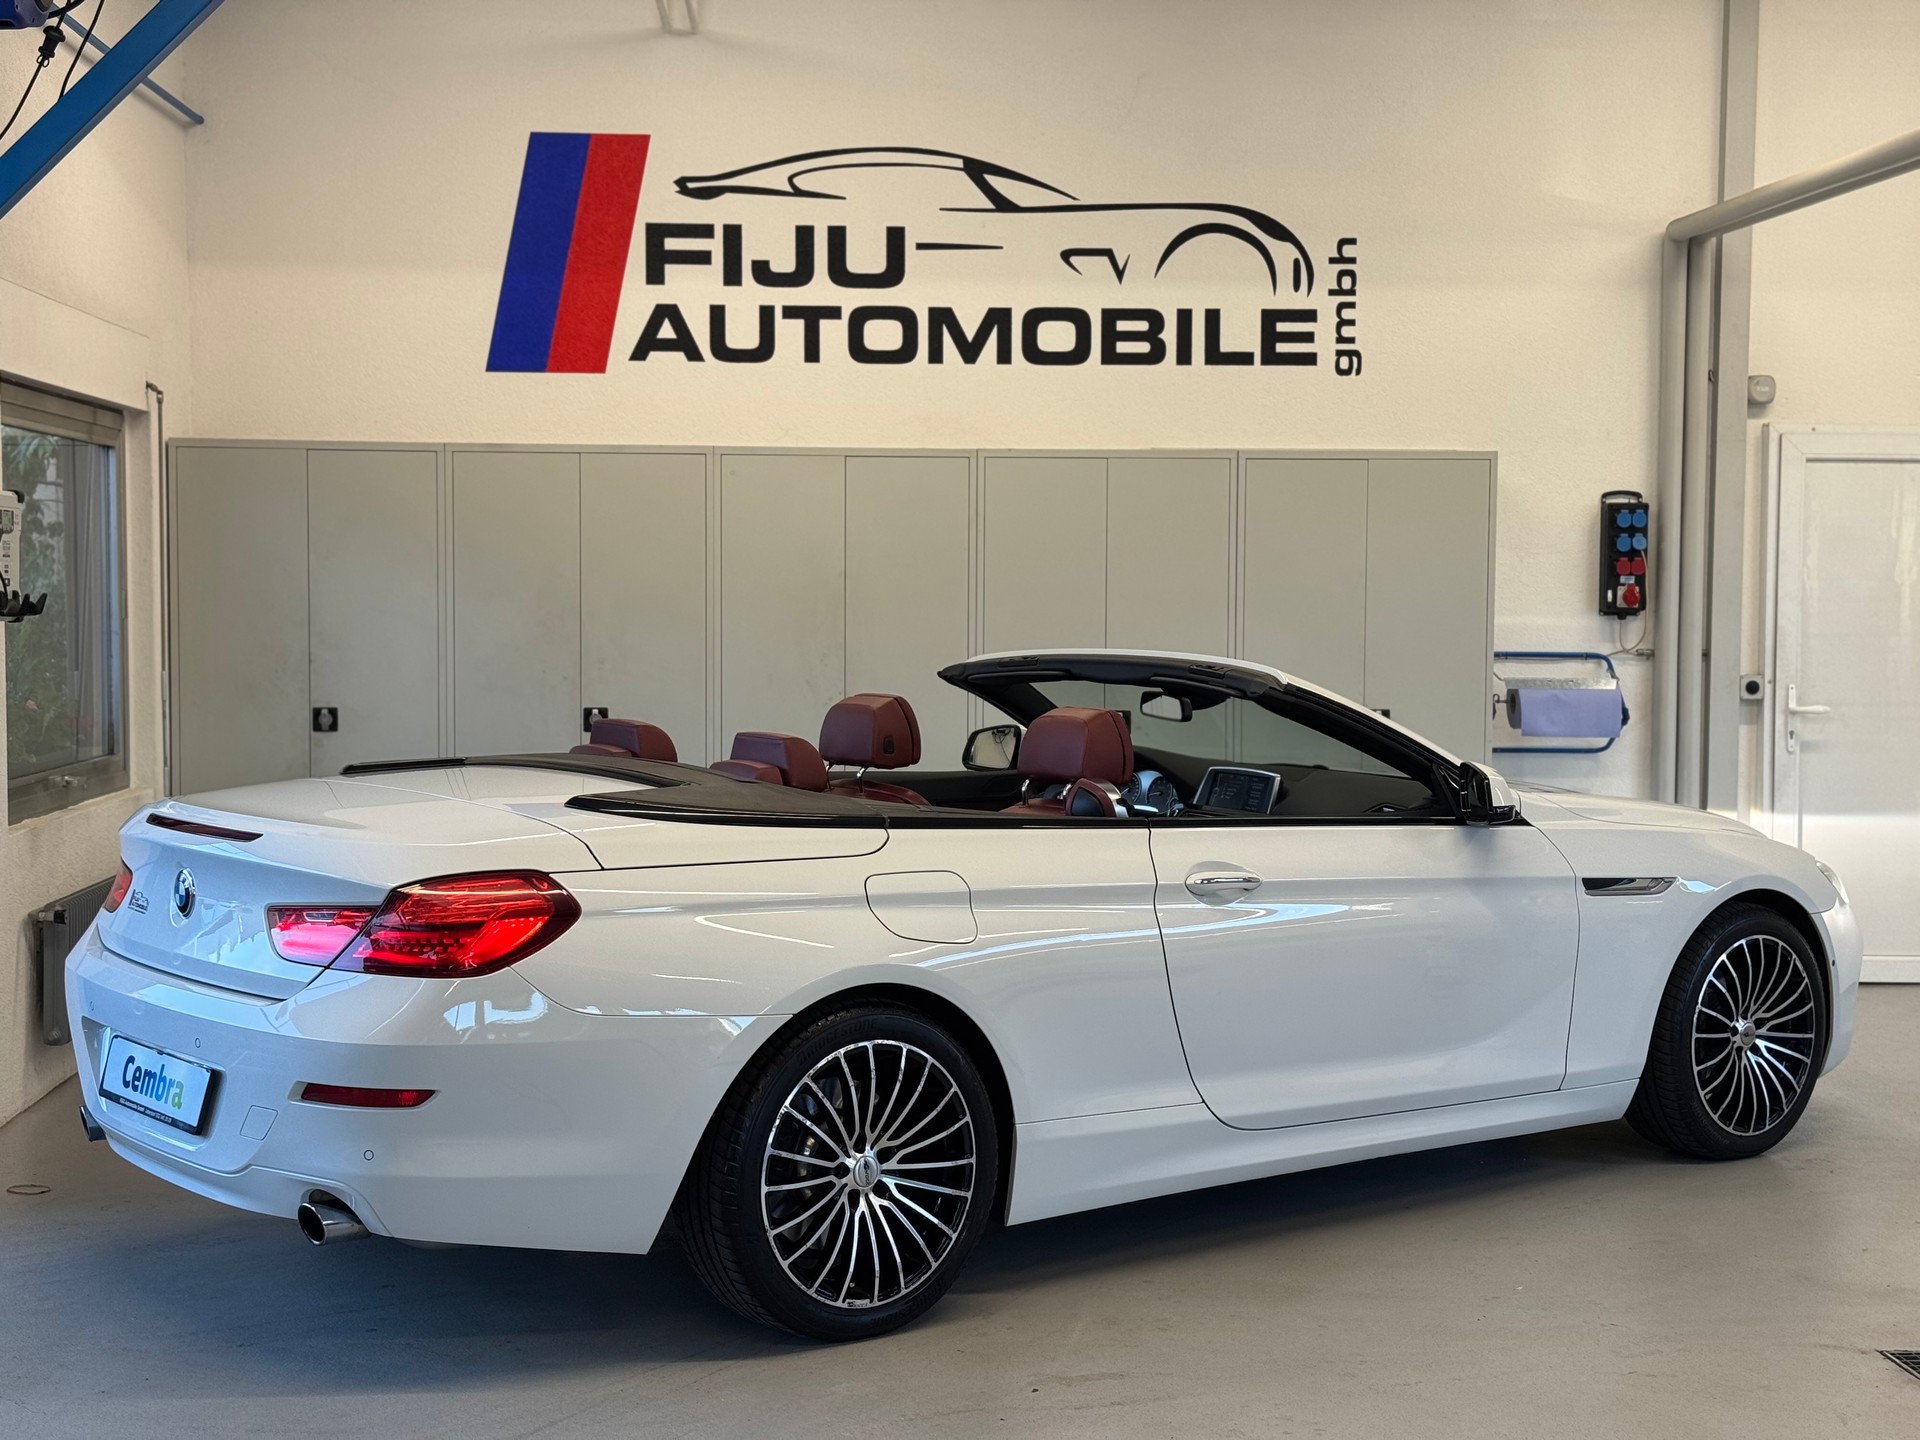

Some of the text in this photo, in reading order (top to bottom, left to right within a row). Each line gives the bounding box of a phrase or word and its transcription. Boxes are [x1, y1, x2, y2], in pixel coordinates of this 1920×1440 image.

[645, 222, 906, 289] FIJU
[627, 303, 1318, 366] AUTOMOBILE
[1327, 237, 1362, 377] gmbh
[122, 1055, 185, 1110] Cembra
